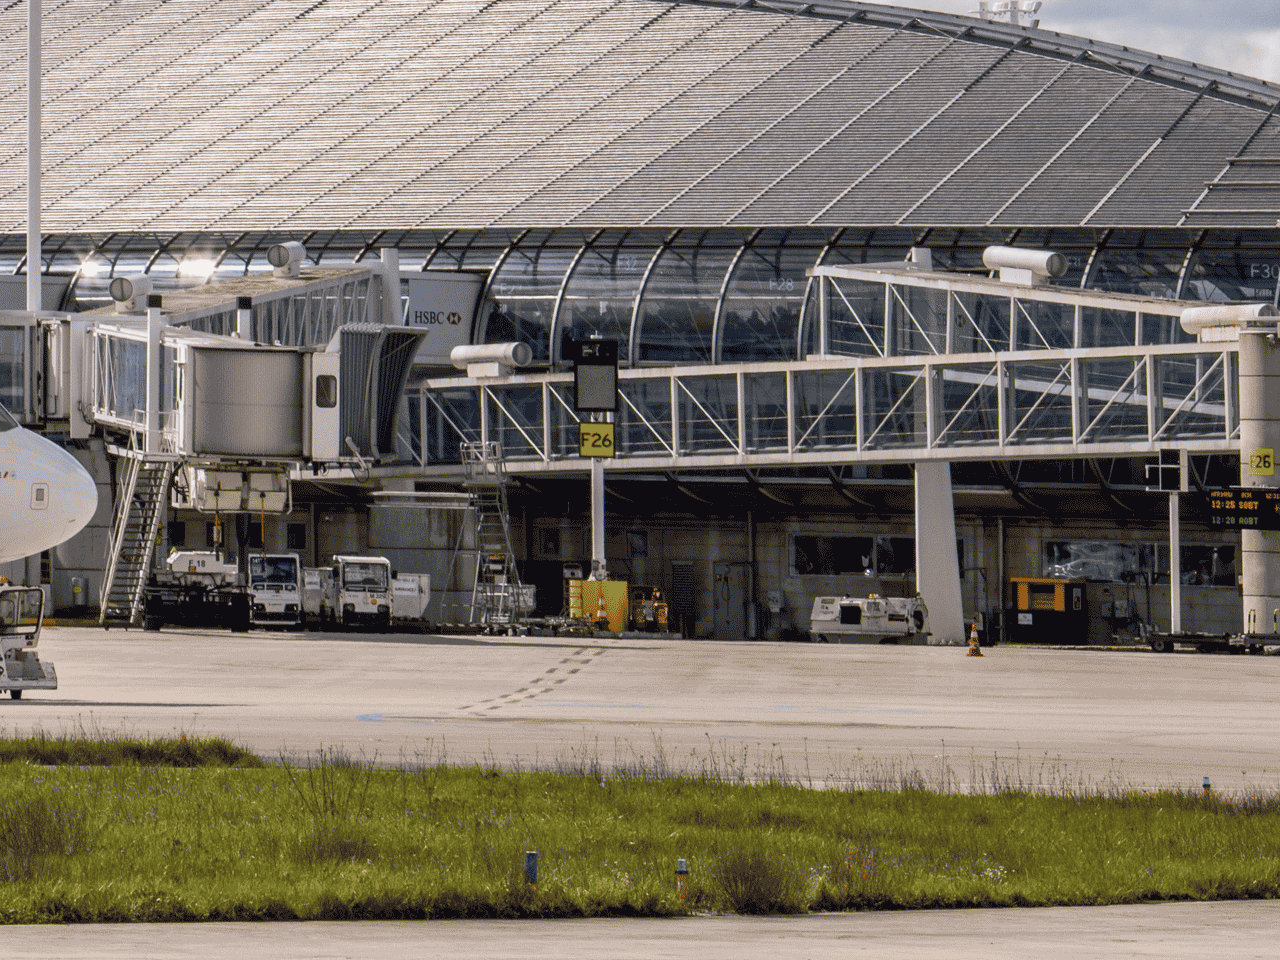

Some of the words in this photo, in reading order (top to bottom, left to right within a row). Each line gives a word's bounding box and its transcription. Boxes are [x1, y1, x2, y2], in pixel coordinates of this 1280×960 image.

[770, 278, 794, 291] F28
[414, 310, 445, 325] HSBC
[581, 432, 613, 448] F26
